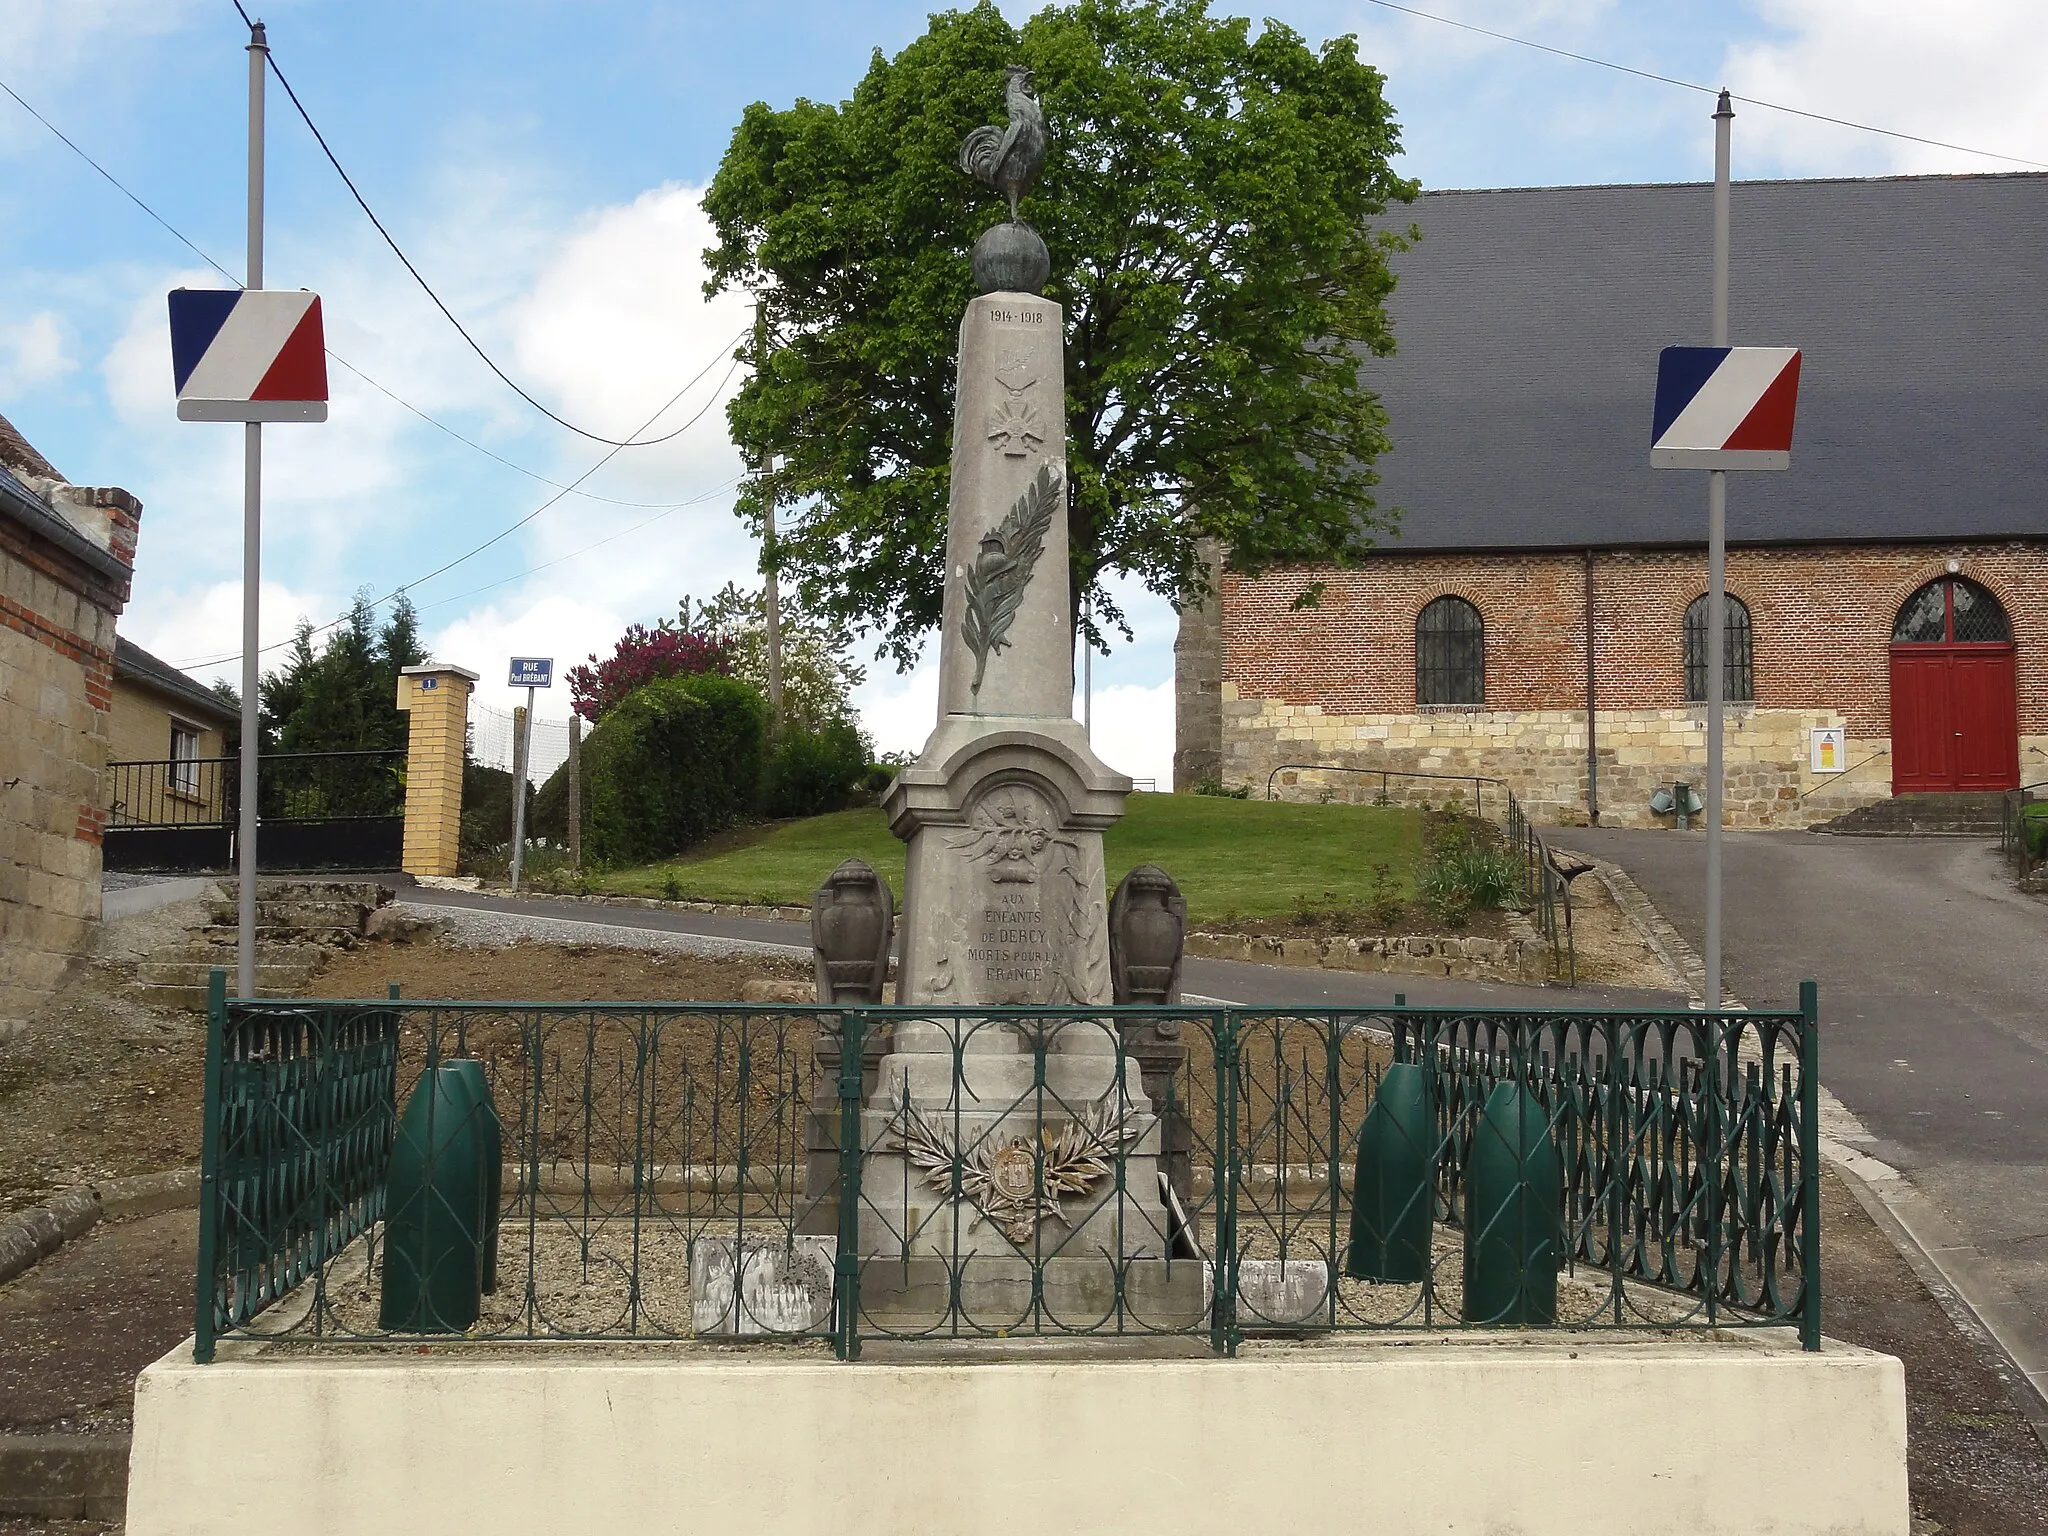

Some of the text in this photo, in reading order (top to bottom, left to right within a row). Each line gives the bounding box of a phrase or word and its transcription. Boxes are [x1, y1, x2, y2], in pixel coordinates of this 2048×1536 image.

[522, 662, 539, 671] RUE
[522, 672, 549, 683] BRÉBANT
[1001, 894, 1025, 905] AUX
[985, 910, 1042, 923] ENFANTS
[982, 929, 1047, 943] DE DERCY
[968, 949, 1010, 961] MORTS
[1013, 952, 1041, 962] POUR
[986, 968, 1042, 981] FRANCE
